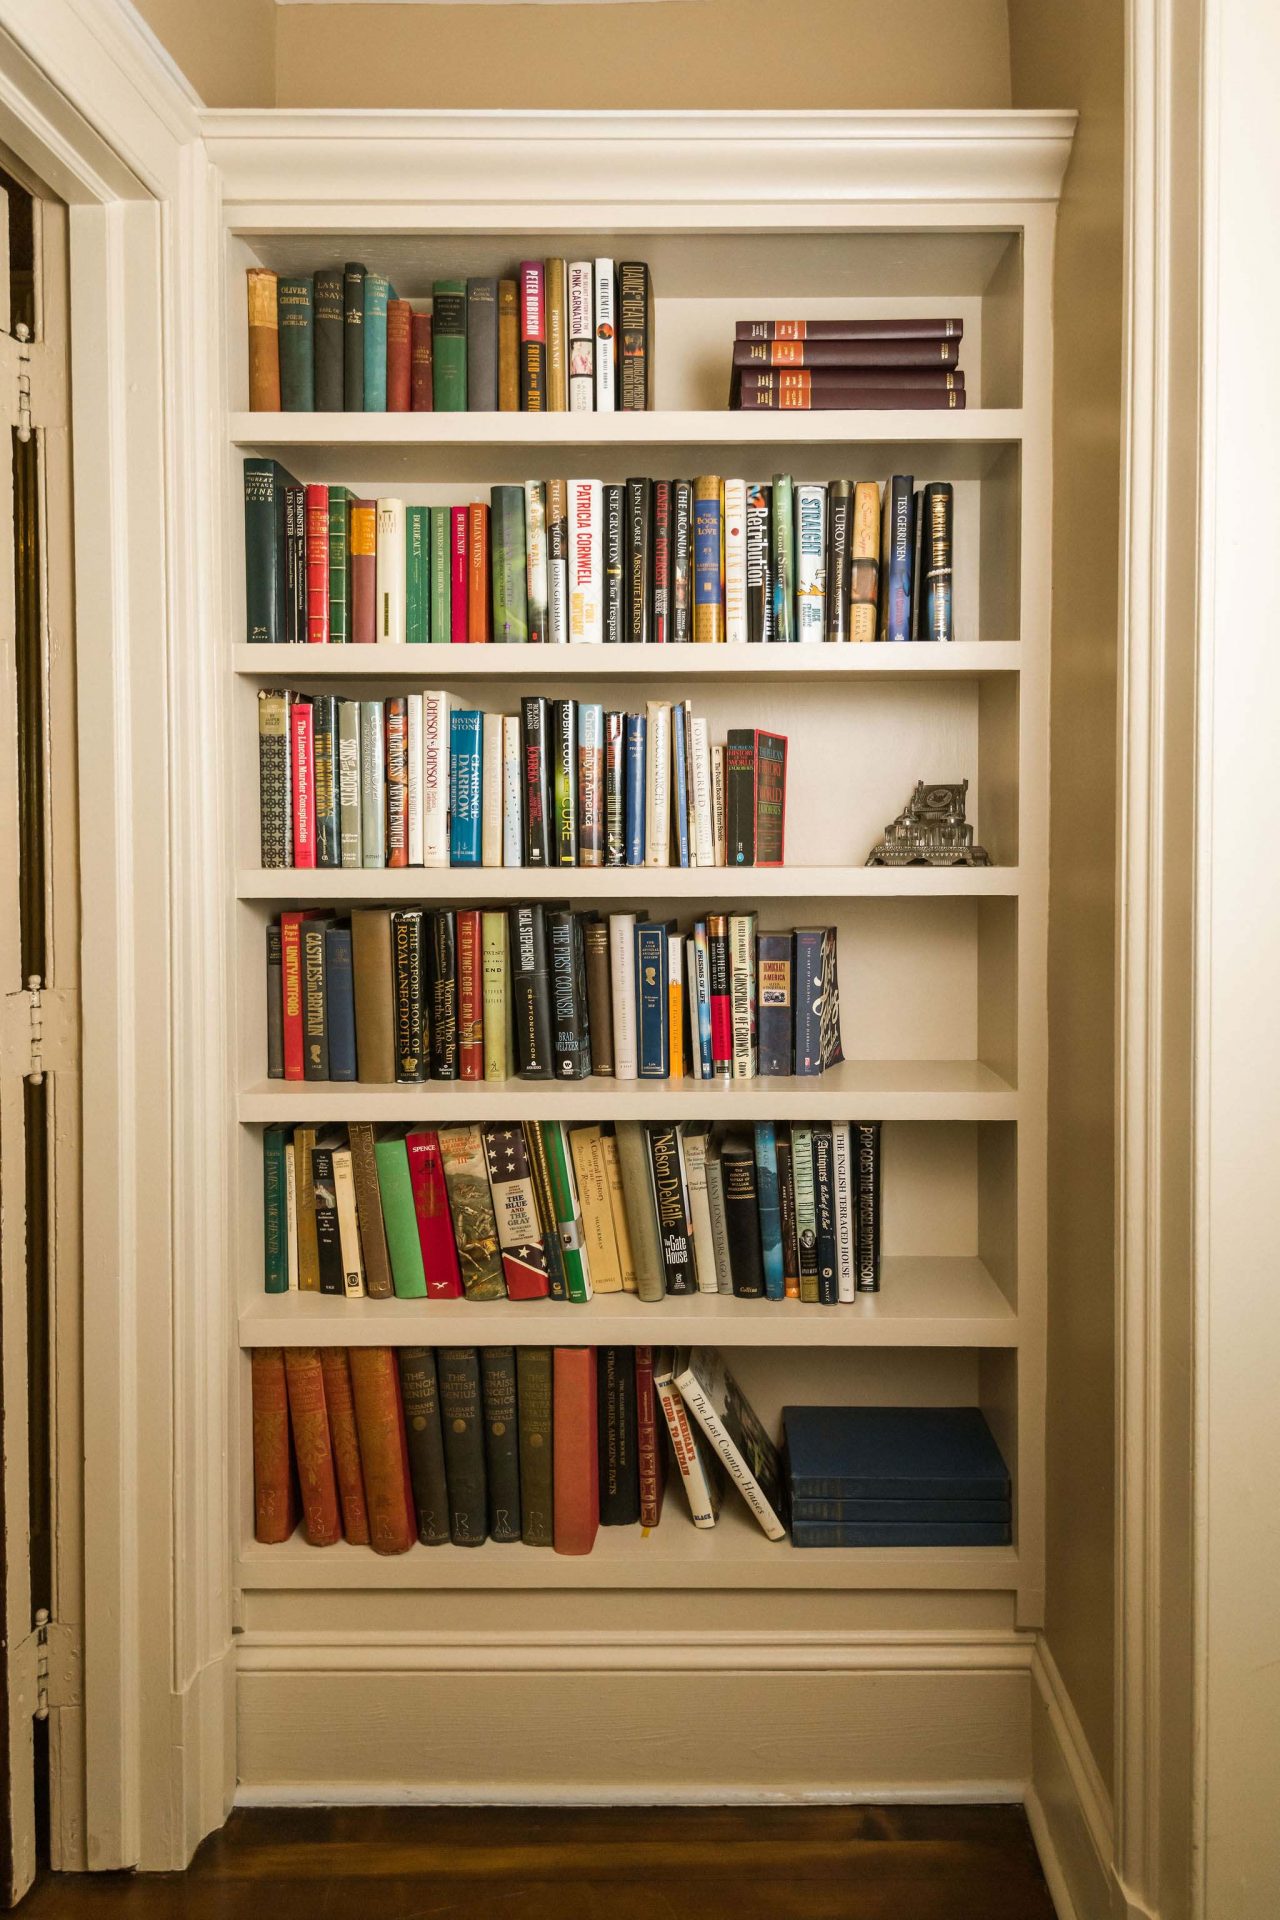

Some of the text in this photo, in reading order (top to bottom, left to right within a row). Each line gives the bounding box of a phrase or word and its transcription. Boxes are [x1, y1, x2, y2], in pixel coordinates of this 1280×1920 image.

[281, 286, 308, 296] OLIVER
[317, 283, 341, 291] LAST
[527, 271, 538, 335] PETER ROBINSON
[572, 270, 581, 334] PINK CARNATION
[600, 278, 609, 320] CHECKMATE
[552, 310, 561, 369] PROVENANCE
[551, 485, 560, 556] THE LAST JUROR
[609, 490, 619, 563] SUE GRAFTON
[656, 484, 668, 527] CONFLICT
[678, 490, 687, 557] THE ARCANUM
[802, 498, 821, 557] STRAIGHT
[897, 496, 907, 560] TESS GERRITSEN
[933, 494, 949, 539] RODERICK
[413, 514, 421, 556] BORDEAUX
[457, 513, 465, 555] BURGUNDY
[474, 510, 482, 568] ITALIAN WINES
[577, 485, 592, 586] PATRICIA CORNWELL
[747, 508, 768, 587] Retribution
[777, 501, 787, 588] The Good Sister
[834, 505, 845, 555] TUROW
[607, 564, 621, 579] T
[656, 537, 668, 585] INTEREST
[933, 541, 949, 566] MANN
[553, 563, 561, 632] JOHN GRISHAM
[572, 592, 584, 636] MORTUARY
[610, 587, 619, 598] for
[633, 552, 642, 634] ABSOLUTE FRIENDS
[812, 608, 820, 621] DICK
[607, 599, 619, 640] Trespass
[390, 714, 403, 730] JOE
[298, 720, 308, 843] The Lincoln Murder Conspiracies
[471, 754, 480, 818] CLARENCE
[527, 744, 540, 783] SOVEREIGN
[583, 711, 594, 826] Christianity in America
[694, 722, 706, 808] POWER & GREED
[390, 784, 403, 812] NEVER
[458, 754, 469, 821] DARROW
[759, 787, 782, 802] WORLD
[390, 815, 403, 848] ENOUGH
[562, 797, 574, 840] CURE
[462, 921, 472, 936] THE
[462, 939, 472, 949] DA
[518, 909, 535, 970] NEAL STEPHENSON
[287, 945, 298, 974] UNITY
[462, 950, 472, 973] VINCI
[553, 924, 574, 1020] THE FIRST COUNSEL
[717, 942, 726, 989] SOTHEBY'S
[764, 963, 785, 972] DEMOCRACY
[764, 973, 785, 981] AMERICA
[287, 975, 298, 1016] MITFORD
[305, 932, 323, 1036] CASTLES in BRITAIN
[397, 925, 410, 1054] ROYAL ANECDOTES
[409, 925, 420, 1053] THE OXFORD BOOK OF
[462, 976, 472, 996] CODE
[699, 980, 705, 988] OF
[434, 979, 445, 1053] With the Wolves
[444, 979, 455, 1064] Women Who Run
[462, 1003, 472, 1020] DAN
[527, 988, 536, 1059] CRYPTONOMICON
[412, 1145, 436, 1153] SPENCE
[817, 1141, 828, 1182] Antiques
[507, 1194, 525, 1203] THE
[652, 1133, 683, 1227] Nelson DeMille
[795, 1142, 815, 1224] PAINFULLY RICH
[860, 1126, 874, 1229] POP GOES THE WEASEL
[505, 1200, 528, 1210] BLUE
[507, 1217, 531, 1227] GRAY
[510, 1212, 527, 1220] THE
[710, 1176, 727, 1278] MANY LONG YEARS AGO
[836, 1133, 850, 1278] THE ENGLISH TERRACED HOUSE
[666, 1248, 688, 1264] House
[861, 1233, 874, 1285] PATTERSON
[406, 1371, 425, 1380] THE
[447, 1374, 467, 1382] THE
[487, 1370, 506, 1378] THE
[662, 1396, 690, 1476] GUIDE TO BRITAIN
[672, 1393, 696, 1462] AN AMERICAN'S
[692, 1394, 765, 1515] The Last Country Houses
[694, 1513, 712, 1521] BLACK
